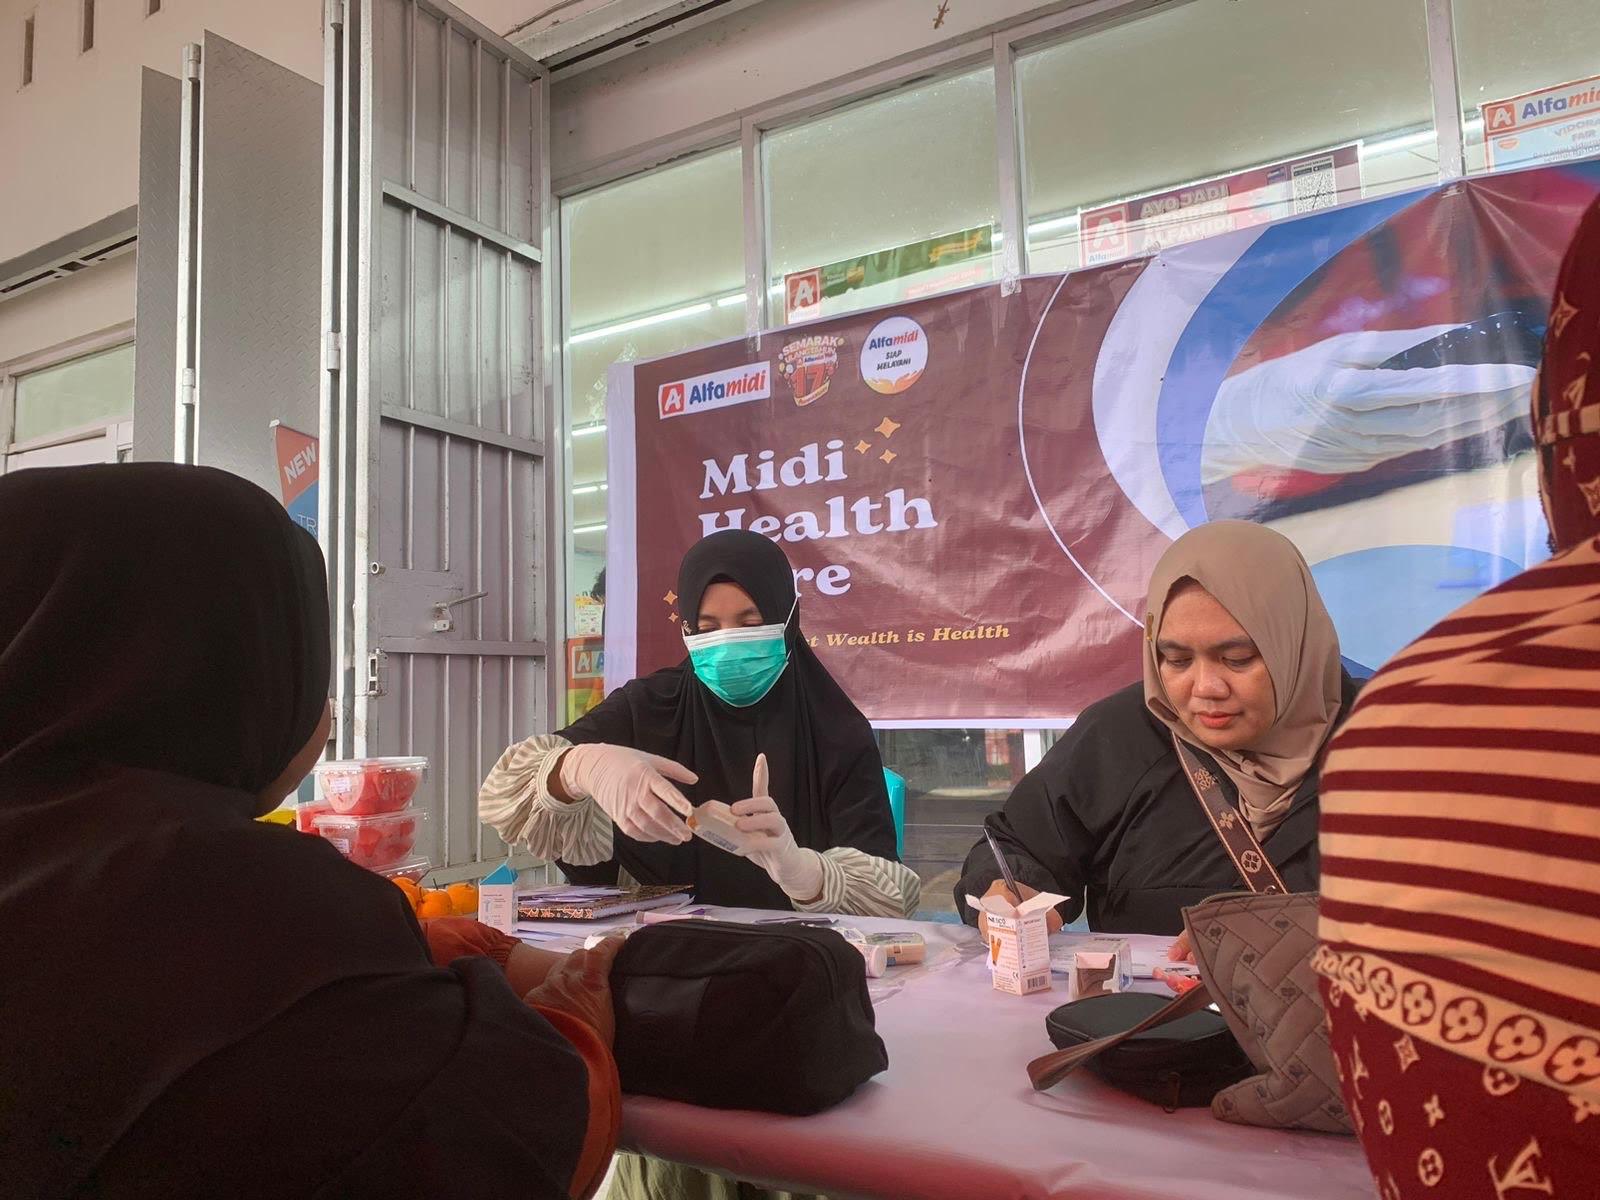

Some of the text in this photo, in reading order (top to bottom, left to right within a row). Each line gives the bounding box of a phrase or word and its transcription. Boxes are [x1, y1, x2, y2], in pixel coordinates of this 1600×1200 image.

[1522, 87, 1600, 119] Alfami
[782, 336, 838, 355] SEMARAK
[868, 329, 919, 350] Alfamidi
[885, 350, 903, 359] SIAP
[689, 370, 766, 405] Alfamidi
[791, 364, 826, 397] 17
[284, 442, 317, 485] NEW
[699, 439, 848, 499] Midi
[698, 488, 939, 543] Health
[792, 564, 851, 596] re
[826, 631, 900, 646] Wealth
[907, 629, 925, 642] is
[931, 625, 1010, 641] Health
